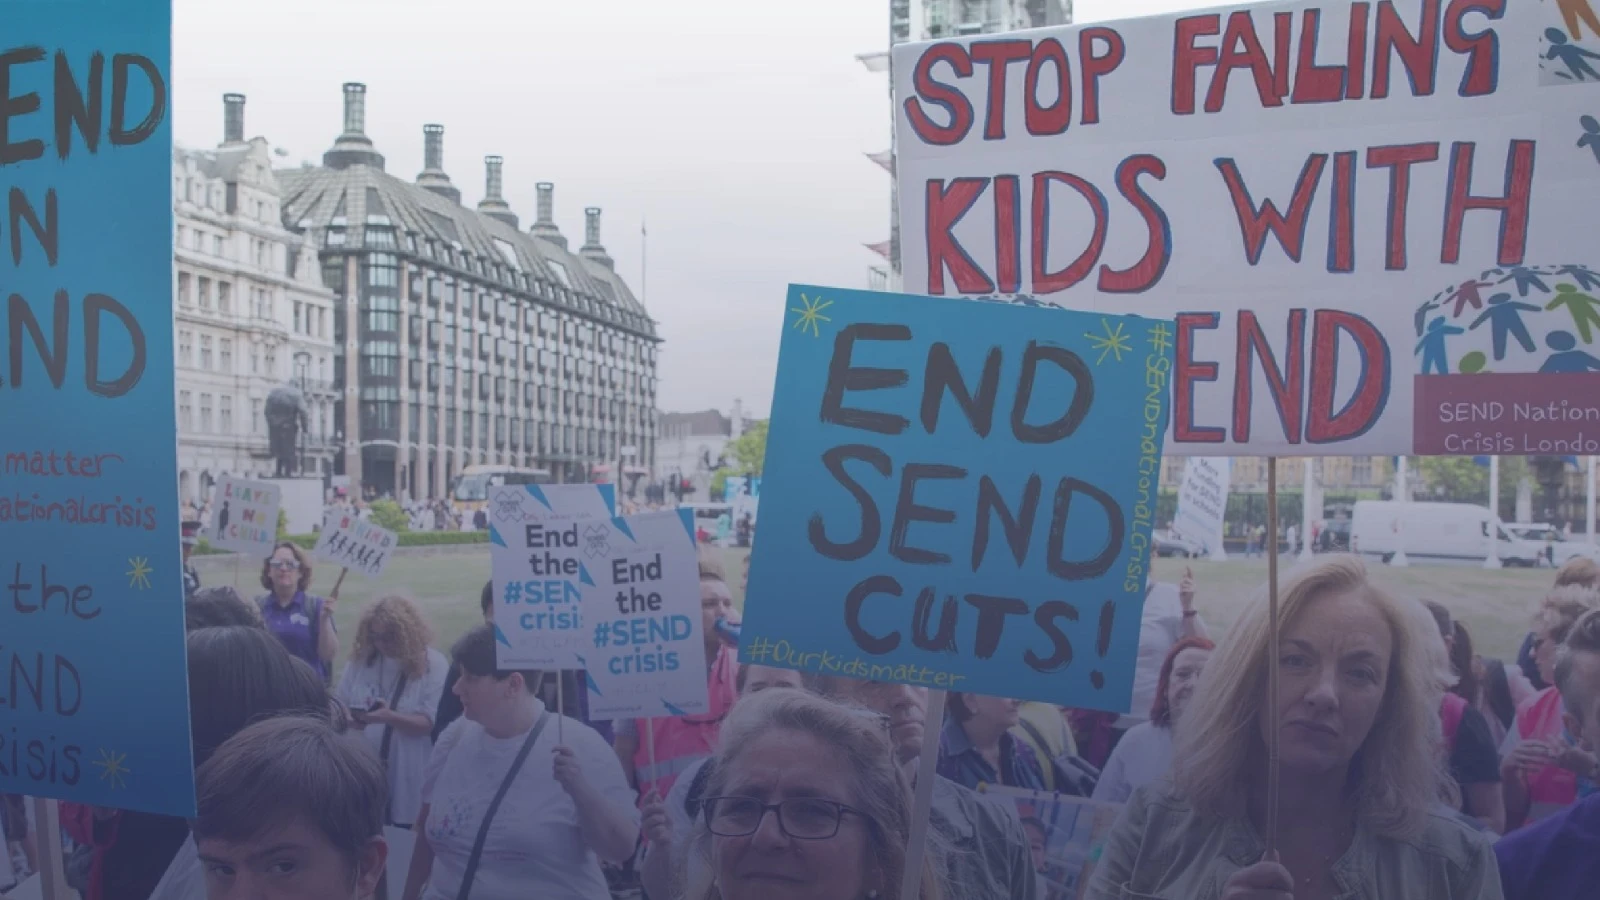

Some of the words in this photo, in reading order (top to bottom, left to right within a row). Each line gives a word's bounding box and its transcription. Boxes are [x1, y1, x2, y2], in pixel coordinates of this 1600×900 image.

[904, 27, 1126, 146] STOP
[1171, 1, 1506, 116] FAILING
[926, 152, 1172, 295] KIDS
[1213, 138, 1536, 273] WITH
[0, 287, 147, 399] ND
[820, 322, 1095, 444] END
[1163, 308, 1392, 445] END
[1439, 402, 1504, 423] SEND
[1514, 400, 1600, 422] Nation
[1444, 432, 1514, 452] Crisis
[1525, 432, 1600, 453] Londo
[6, 451, 124, 477] matter
[808, 443, 1126, 581] SEND
[525, 523, 578, 548] End
[529, 551, 578, 576] the
[611, 553, 662, 585] End
[8, 561, 101, 620] the
[615, 587, 662, 614] the
[519, 606, 584, 630] crisi
[593, 614, 692, 648] #SEND
[844, 575, 1116, 690] CUTS!
[608, 645, 679, 675] crisis
[0, 645, 82, 717] ND
